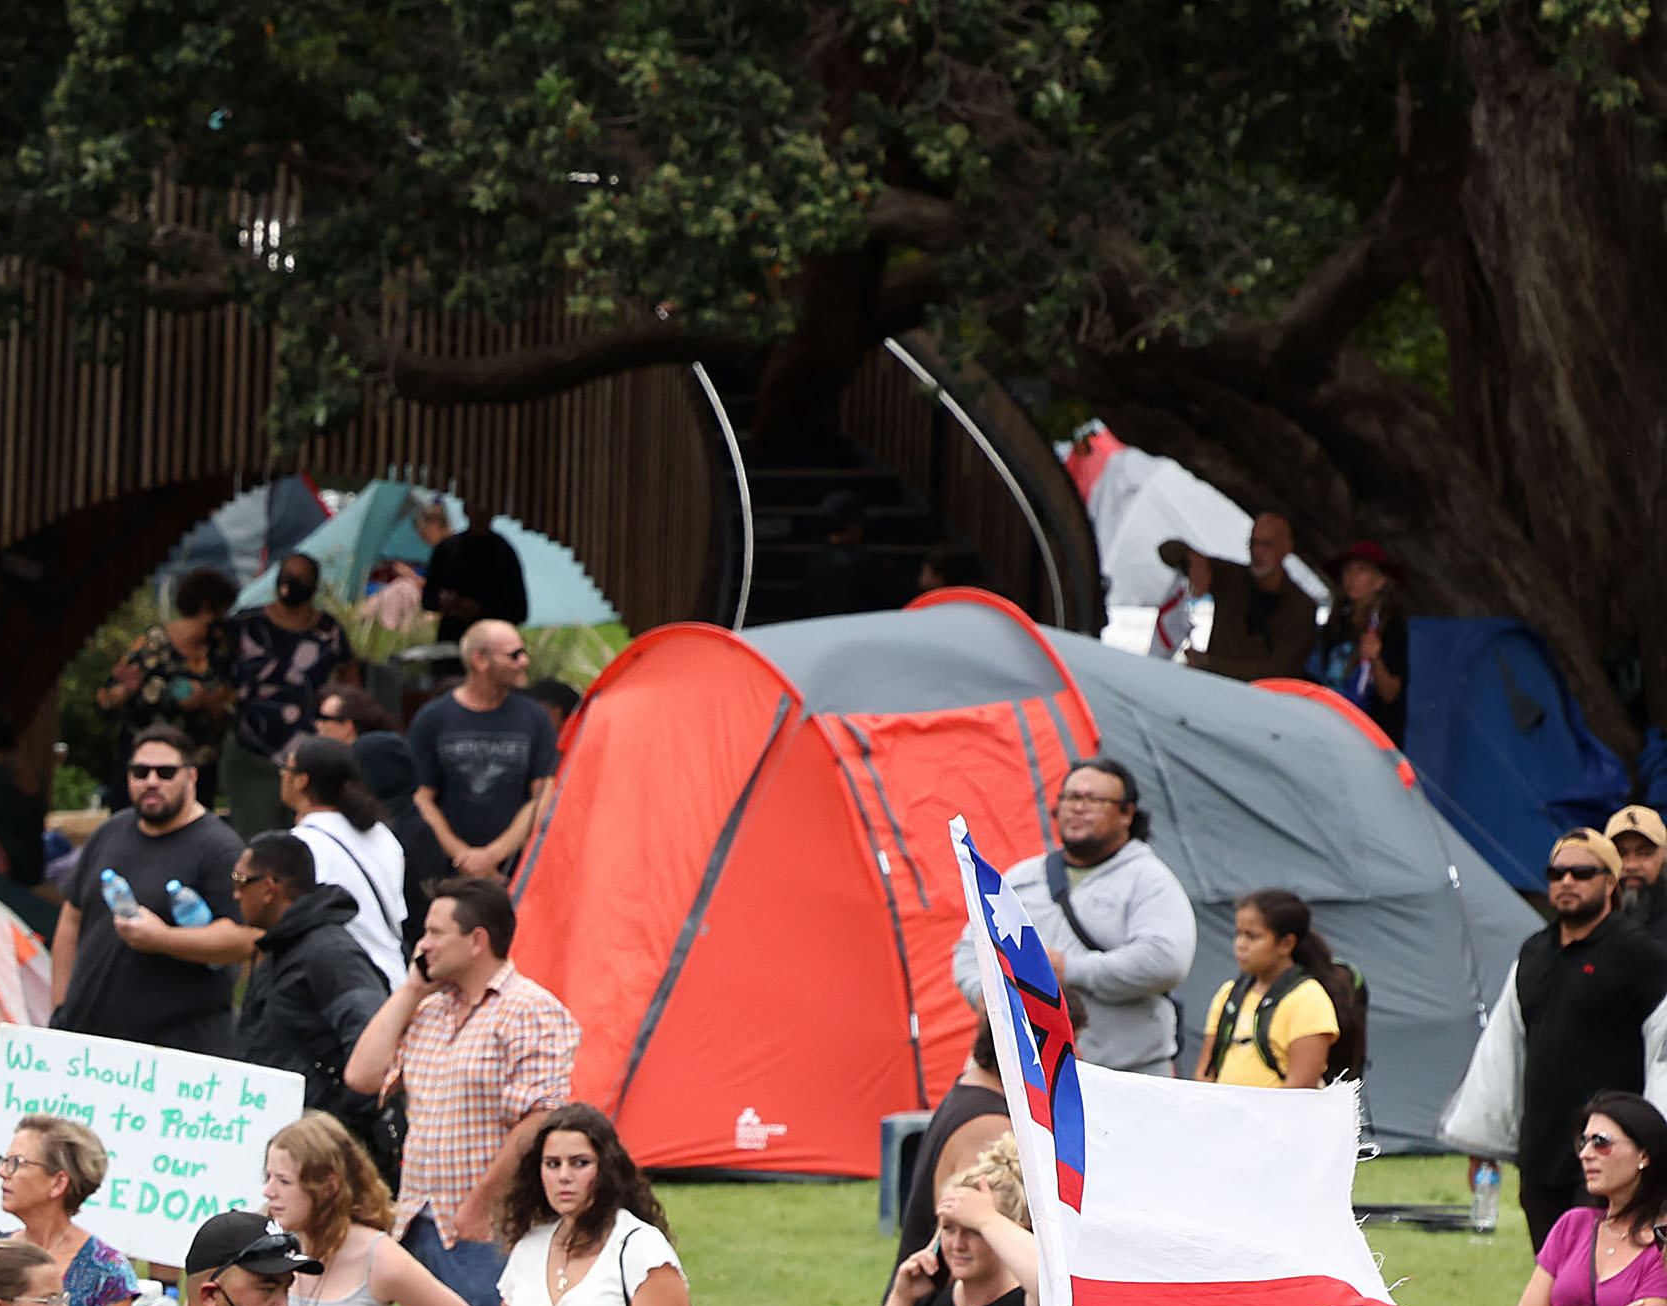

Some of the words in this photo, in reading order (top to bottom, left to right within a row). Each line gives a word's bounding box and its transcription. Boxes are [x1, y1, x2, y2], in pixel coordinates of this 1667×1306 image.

[5, 1040, 50, 1072] We
[67, 1048, 157, 1092] should
[177, 1073, 220, 1101] not
[241, 1077, 268, 1110] be
[4, 1082, 95, 1127] having
[111, 1103, 145, 1132] to
[153, 1154, 207, 1178] our
